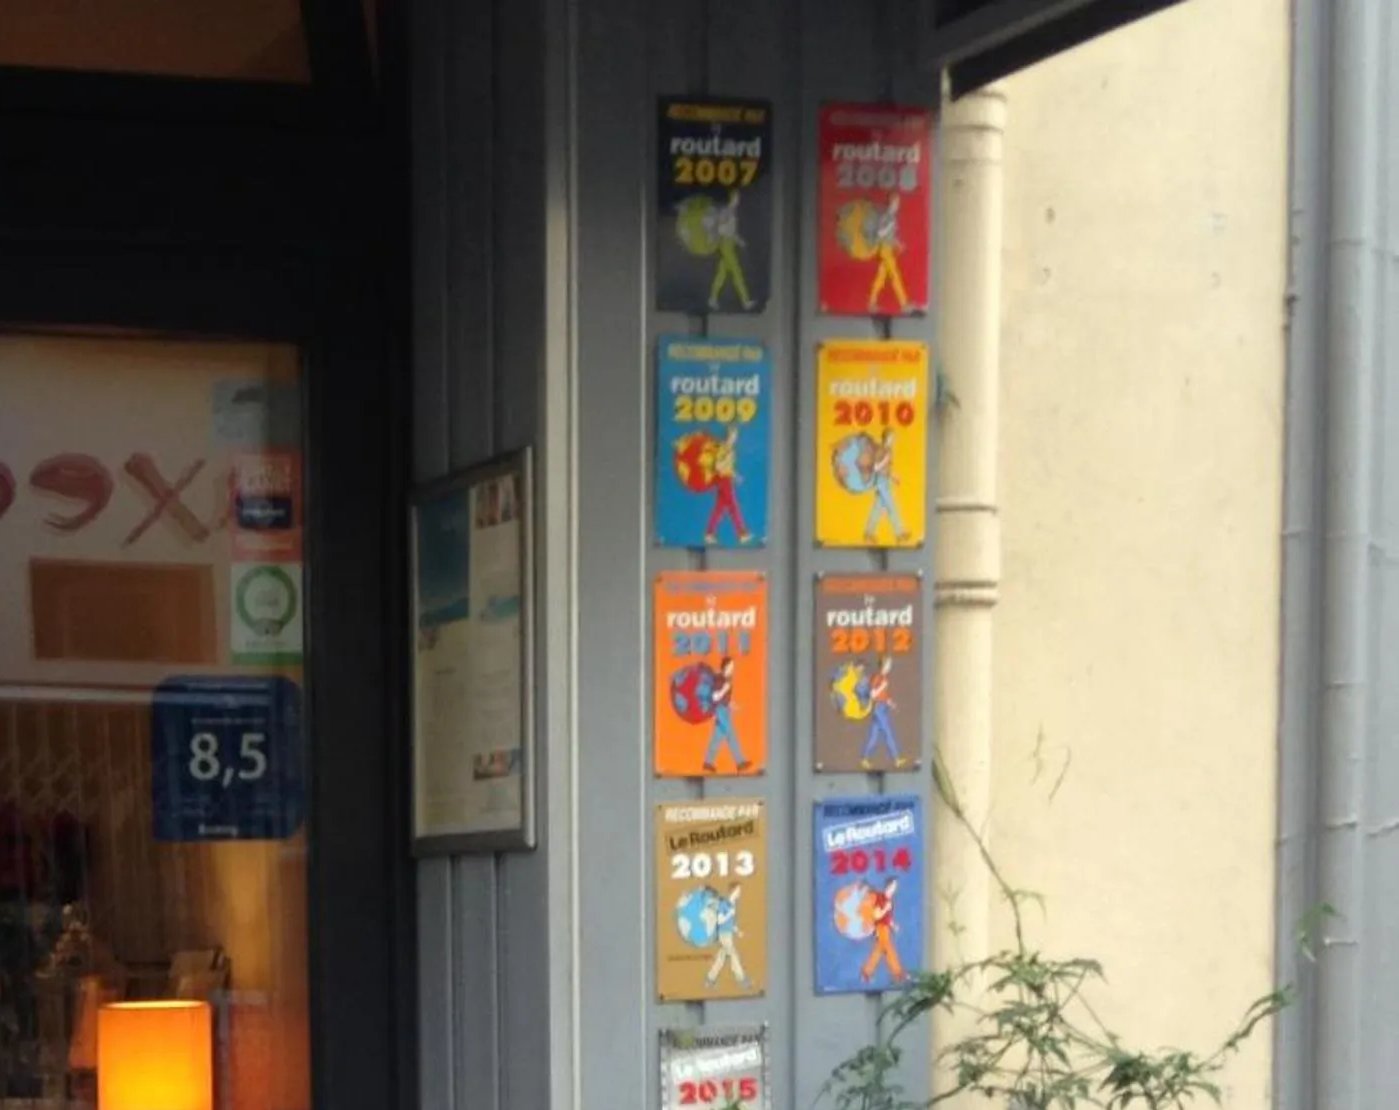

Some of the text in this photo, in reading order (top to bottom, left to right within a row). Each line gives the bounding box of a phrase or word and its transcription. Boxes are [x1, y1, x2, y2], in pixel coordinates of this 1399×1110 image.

[670, 137, 762, 157] routard
[832, 141, 921, 163] routard
[673, 157, 759, 186] 2007
[670, 374, 760, 395] routard
[829, 378, 917, 398] routard
[673, 396, 758, 423] 2009
[833, 400, 915, 427] 2010
[666, 607, 757, 629] routard
[826, 606, 914, 627] routard
[670, 630, 751, 656] 2011
[830, 628, 914, 653] 2012
[188, 732, 267, 788] 8,5
[690, 820, 754, 845] Routard
[671, 851, 755, 879] 2013
[830, 847, 912, 876] 2014
[678, 1077, 758, 1105] 2015
